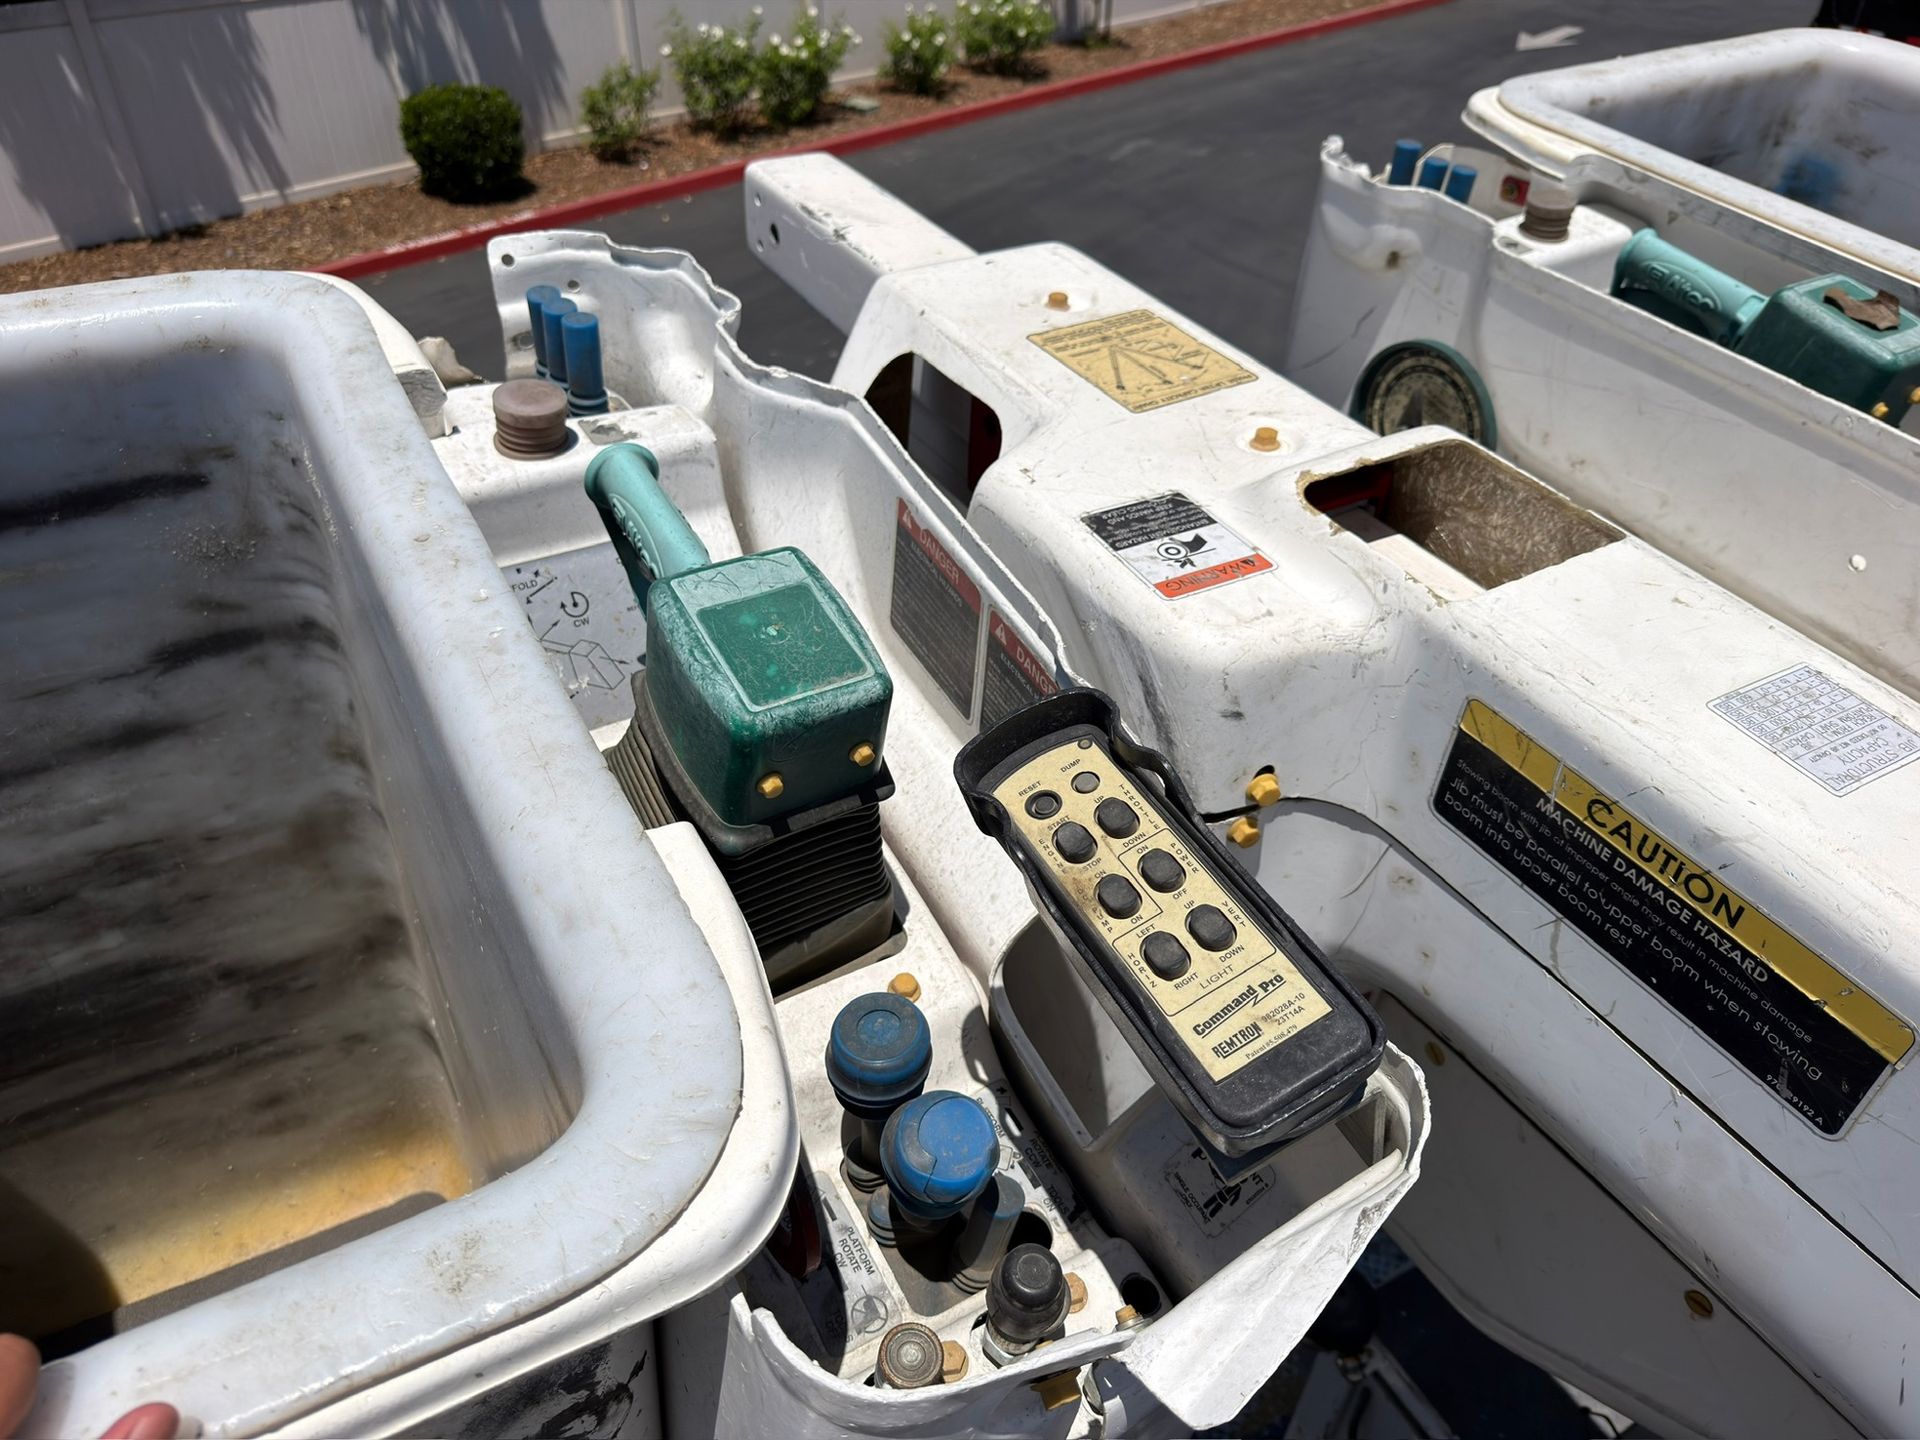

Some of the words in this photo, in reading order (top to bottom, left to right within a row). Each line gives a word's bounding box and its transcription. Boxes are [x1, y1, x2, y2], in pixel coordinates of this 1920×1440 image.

[919, 529, 961, 585] DANGER
[511, 579, 538, 592] FOLD
[573, 617, 590, 628] CW
[1835, 736, 1889, 765] CAPACITY
[1060, 759, 1081, 772] DUMP
[1825, 749, 1899, 786] STRUCTURAL
[1018, 781, 1041, 797] RESET
[1094, 795, 1104, 803] UP
[1047, 815, 1070, 831] START
[1122, 832, 1146, 848] DOWN
[1136, 845, 1149, 854] ON
[1170, 842, 1199, 874] POWER
[1082, 857, 1102, 872] STOP
[1444, 791, 1483, 829] boom
[1485, 824, 1510, 850] into
[1514, 849, 1556, 886] upper
[1557, 883, 1602, 925] boom
[1604, 923, 1632, 948] rest
[1586, 797, 1745, 930] CAUTION
[1094, 869, 1107, 879] ON
[1172, 888, 1187, 900] OFF
[1536, 798, 1612, 862] MACHINE
[1613, 857, 1692, 924] DAMAGE
[1694, 920, 1768, 982] HAZARD
[1183, 900, 1195, 909] UP
[1221, 900, 1246, 927] VERT
[1130, 914, 1143, 924] ON
[1491, 786, 1518, 811] boom
[1520, 810, 1539, 827] with
[1538, 824, 1552, 837] jib
[1565, 843, 1609, 882] improper
[1610, 882, 1640, 907] angle
[1641, 906, 1665, 927] may
[1666, 926, 1695, 950] result
[1696, 947, 1706, 960] in
[1708, 958, 1758, 1000] machine
[1761, 1000, 1812, 1043] damage
[1136, 923, 1155, 939] LEFT
[1450, 777, 1468, 796] Jib
[1471, 794, 1503, 823] must
[1504, 818, 1525, 840] be
[1526, 835, 1581, 885] parallel
[1583, 882, 1598, 899] to
[1601, 898, 1648, 938] upper
[1650, 936, 1699, 982] boom
[1705, 980, 1750, 1022] when
[1753, 1021, 1822, 1081] stowing
[1219, 945, 1245, 963] DOWN
[1174, 972, 1198, 990] RIGHT
[1199, 964, 1233, 989] LIGHT
[1192, 985, 1259, 1036] Command
[1258, 974, 1284, 993] Pro
[1274, 1005, 1305, 1026] 23T14A
[1211, 1021, 1262, 1058] REMTRON
[1245, 1044, 1267, 1060] Patent
[1025, 1147, 1041, 1168] CCW
[1043, 1198, 1057, 1212] ON
[1047, 1185, 1070, 1215] TOOLS
[835, 1252, 848, 1268] CW
[838, 1238, 862, 1274] ROTATE
[846, 1226, 875, 1276] PLATFORM
